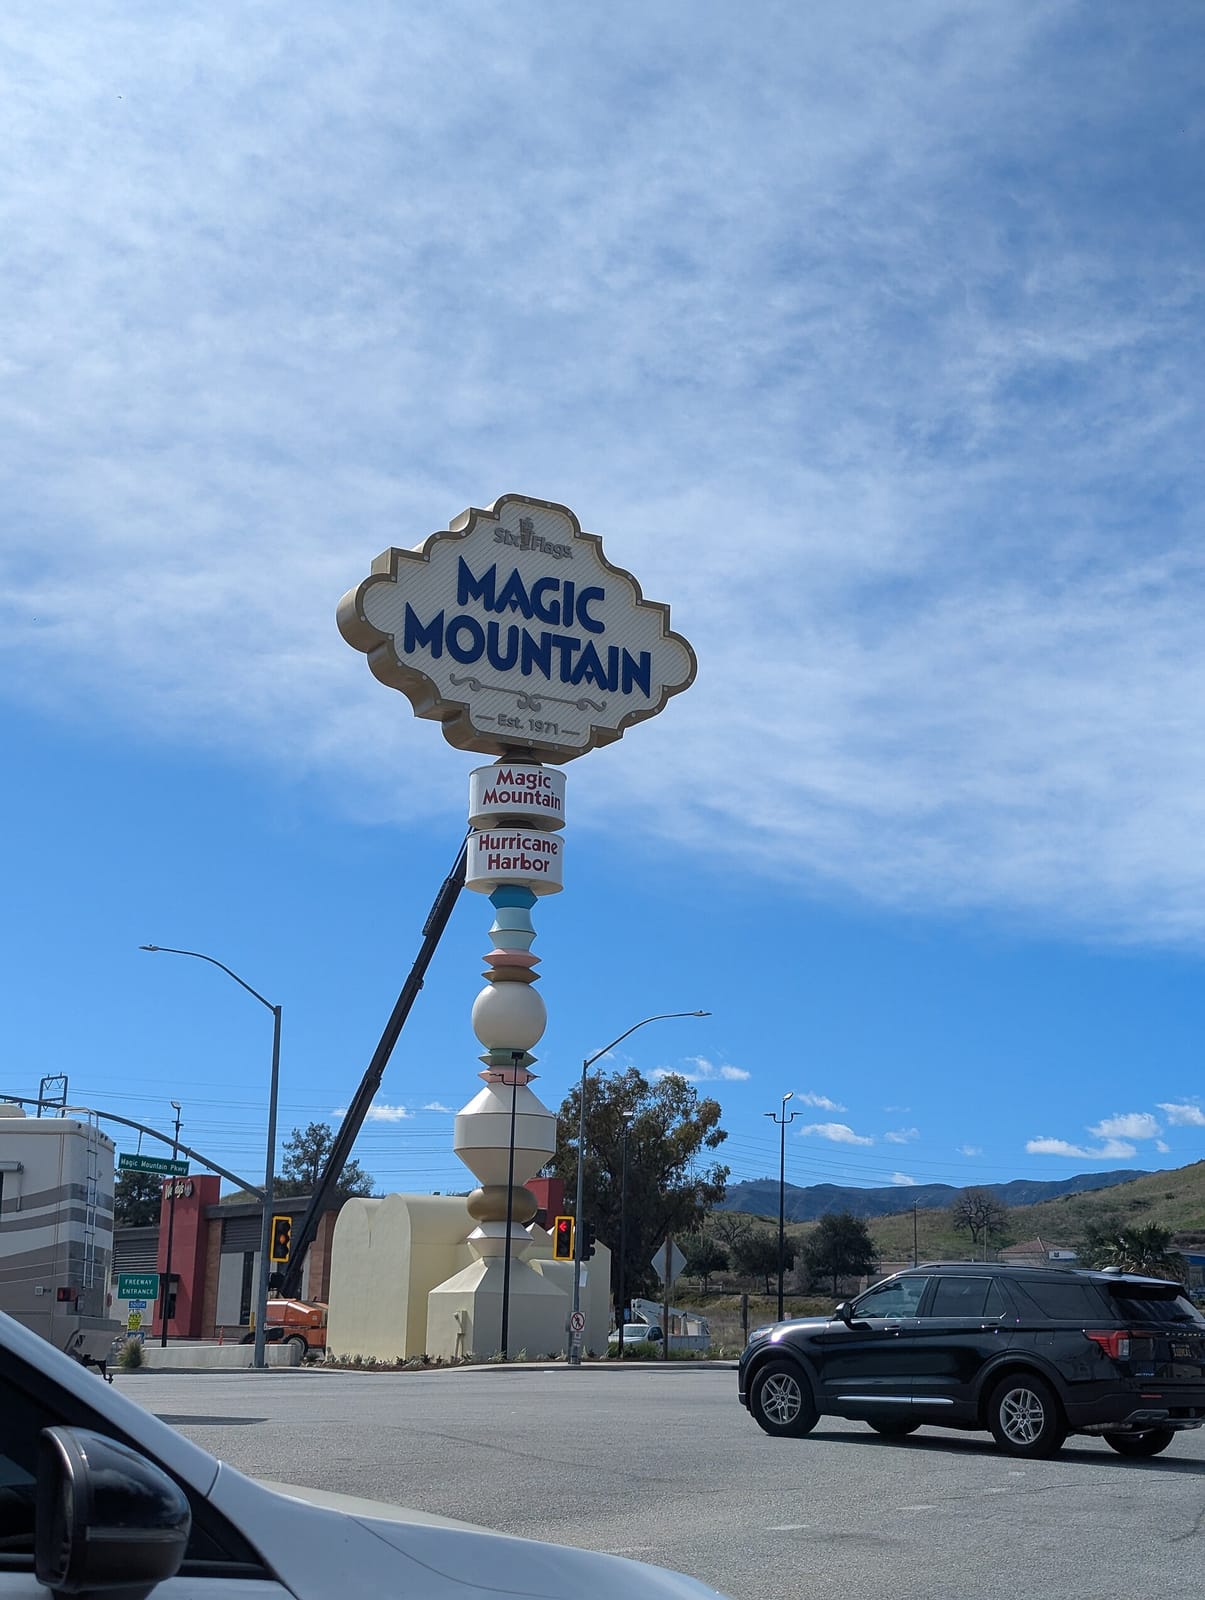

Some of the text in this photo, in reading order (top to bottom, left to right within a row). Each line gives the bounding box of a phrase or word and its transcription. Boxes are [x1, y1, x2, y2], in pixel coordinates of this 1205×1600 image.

[493, 527, 574, 560] Six Flags
[456, 555, 605, 634] MAGIC
[403, 601, 652, 699] MOUNTAIN
[497, 713, 559, 735] Est. 1971
[495, 768, 552, 790] Magic
[482, 787, 561, 811] Mountain
[478, 832, 559, 855] Hurricane
[487, 852, 551, 873] Harbor
[120, 1157, 188, 1174] Magic Mountain Pkwy
